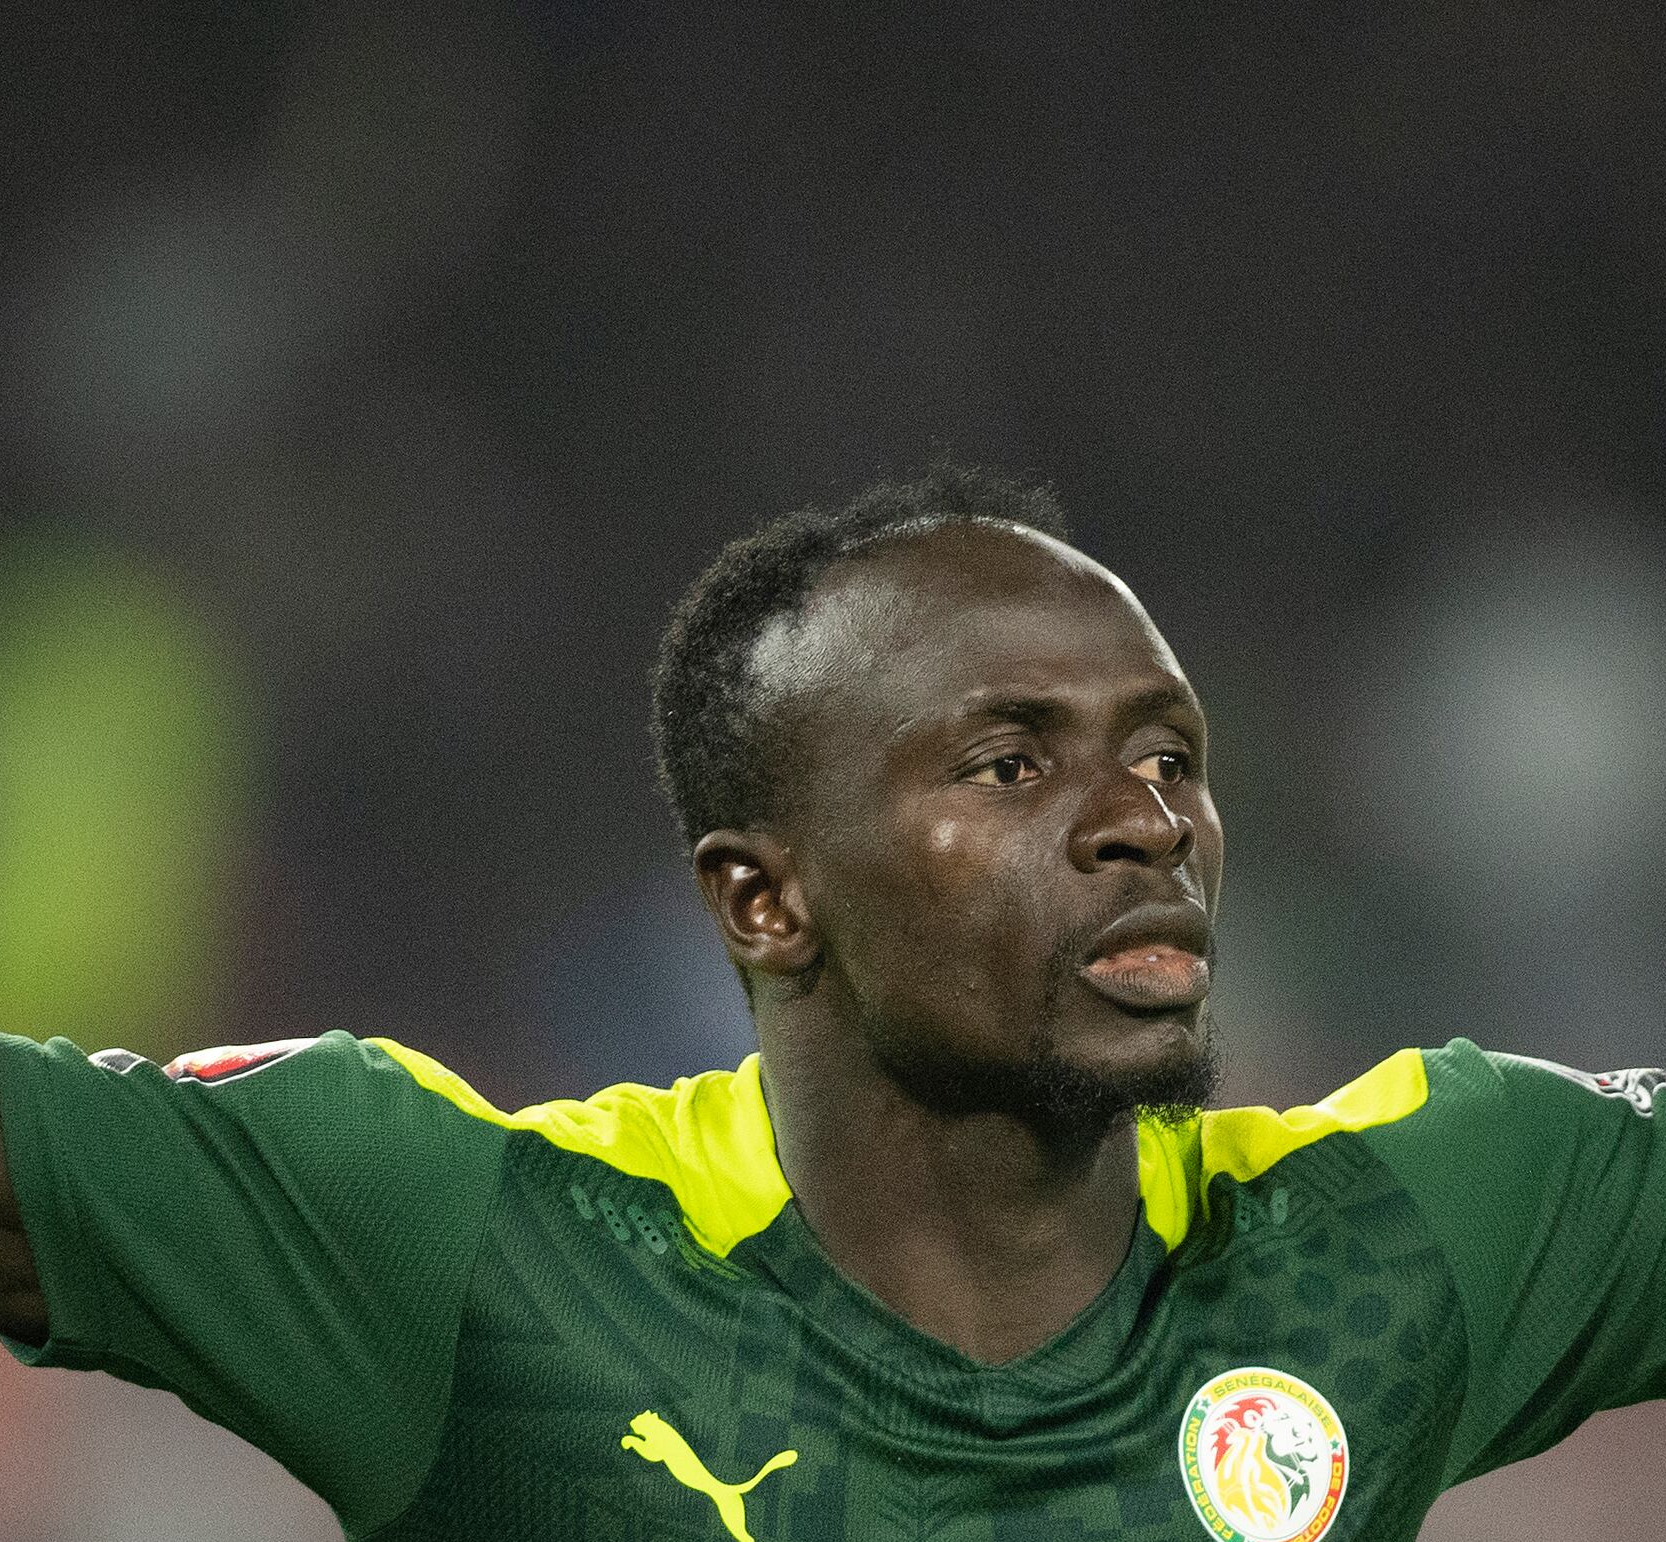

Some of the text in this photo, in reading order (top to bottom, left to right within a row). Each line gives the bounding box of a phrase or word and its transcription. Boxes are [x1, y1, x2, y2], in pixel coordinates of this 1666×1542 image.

[1185, 1417, 1234, 1541] FÉDÉRATION
[1214, 1373, 1334, 1429] SÉNÉGALAISE
[1331, 1461, 1343, 1491] DE
